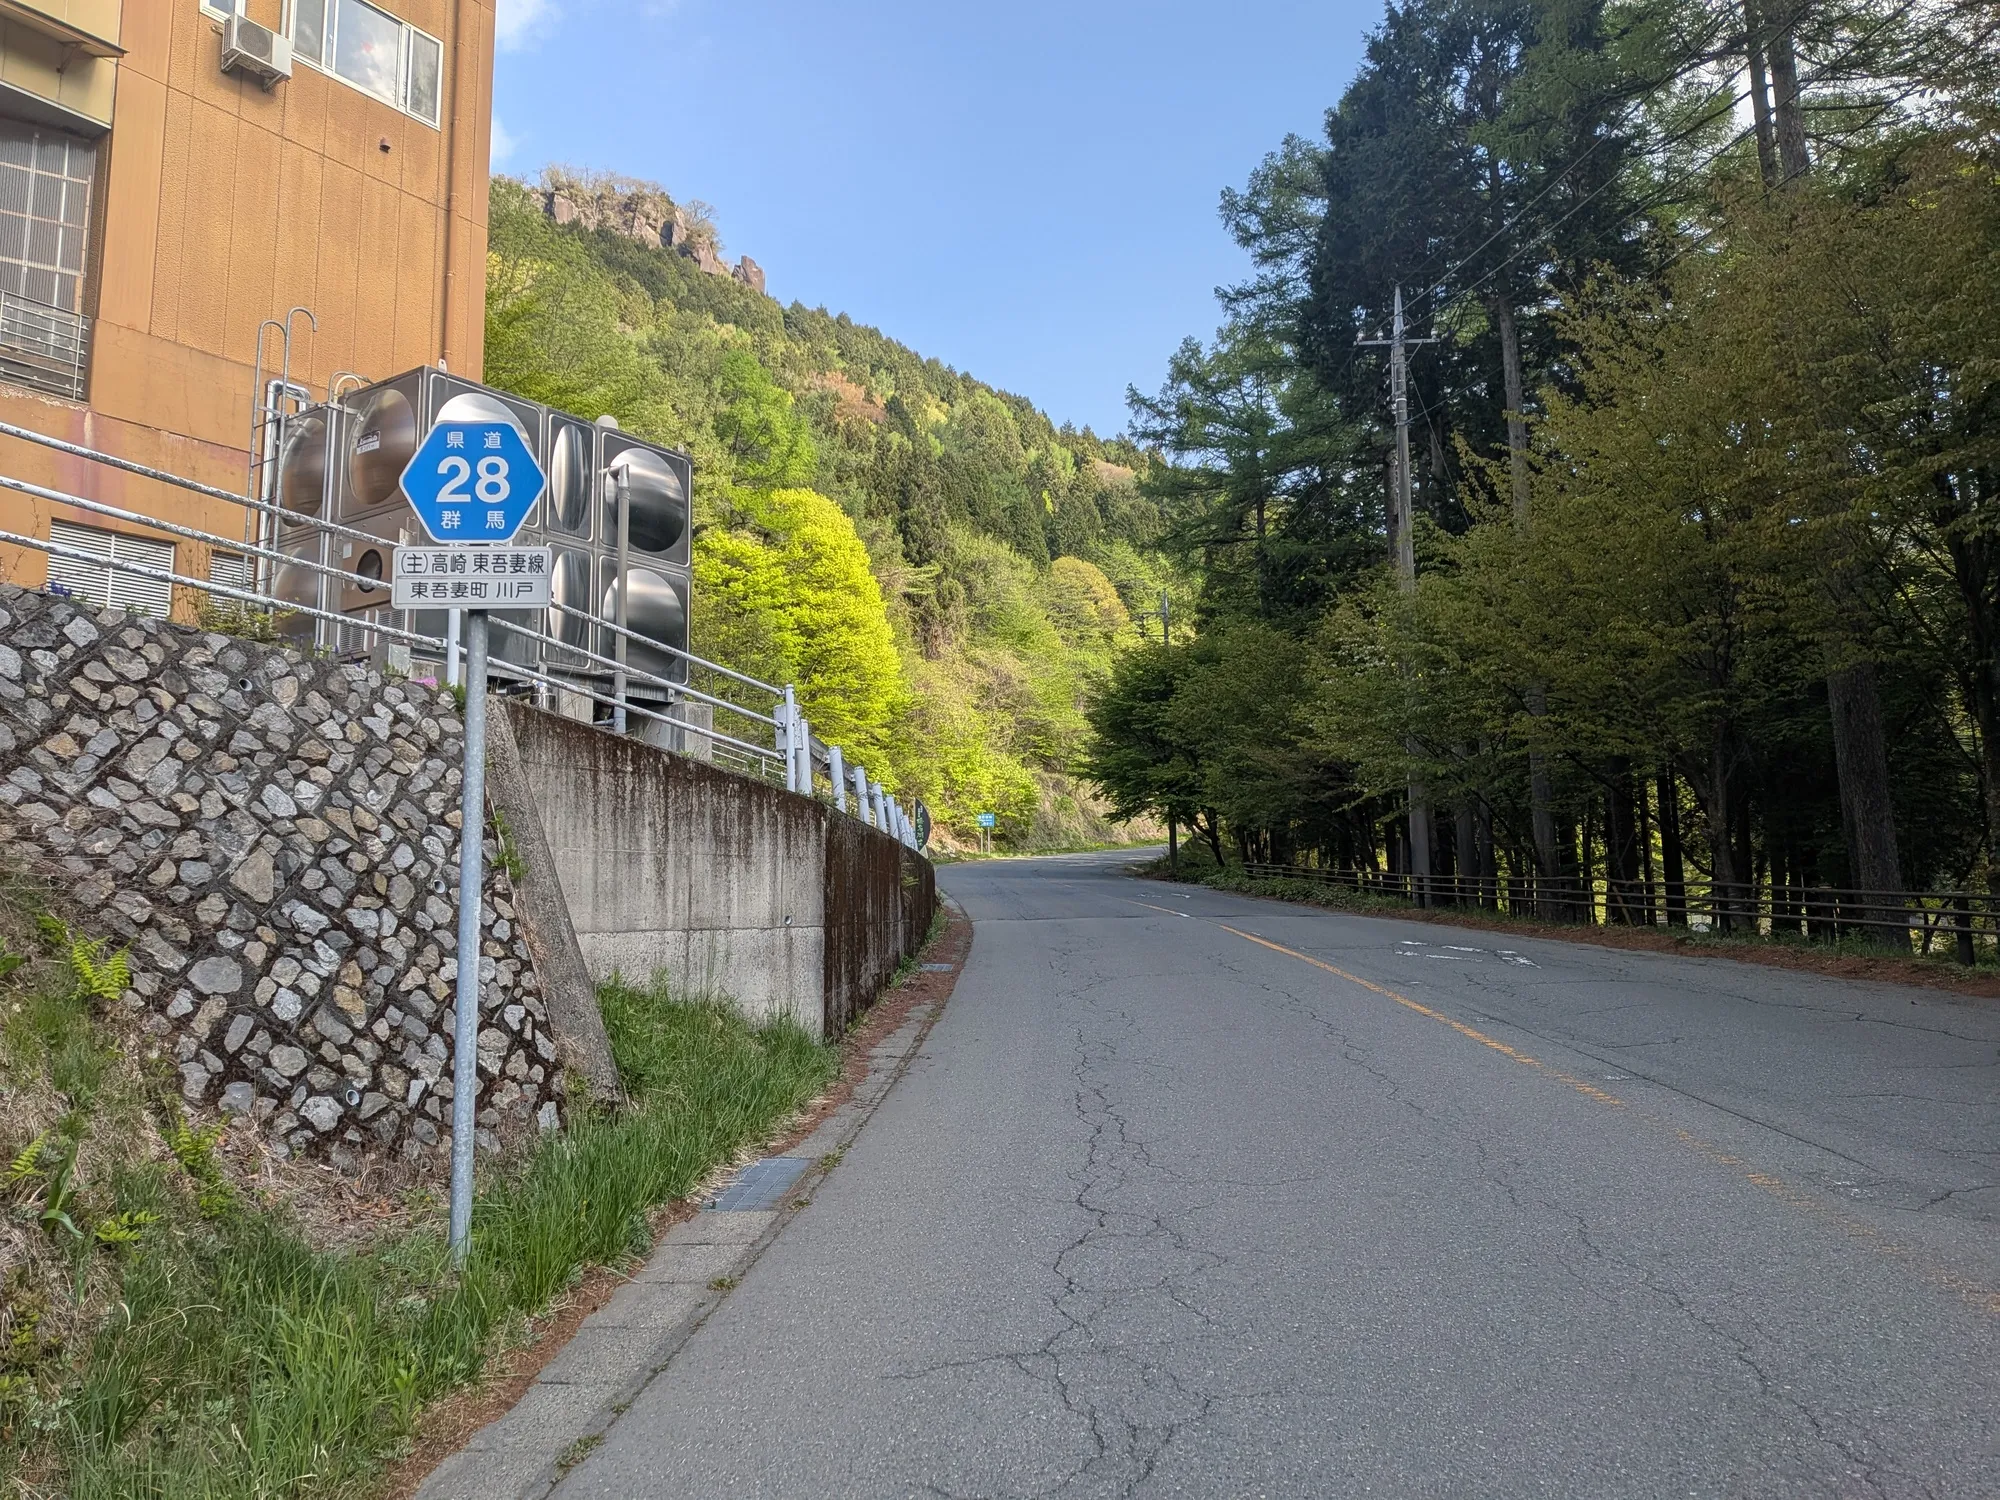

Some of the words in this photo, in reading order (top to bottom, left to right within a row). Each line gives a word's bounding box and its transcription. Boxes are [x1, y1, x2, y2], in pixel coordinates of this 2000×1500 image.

[446, 431, 502, 449] 県道
[435, 456, 511, 503] 28
[440, 510, 505, 530] 群馬
[410, 581, 488, 599] 東吾妻町
[495, 581, 534, 598] 川戸
